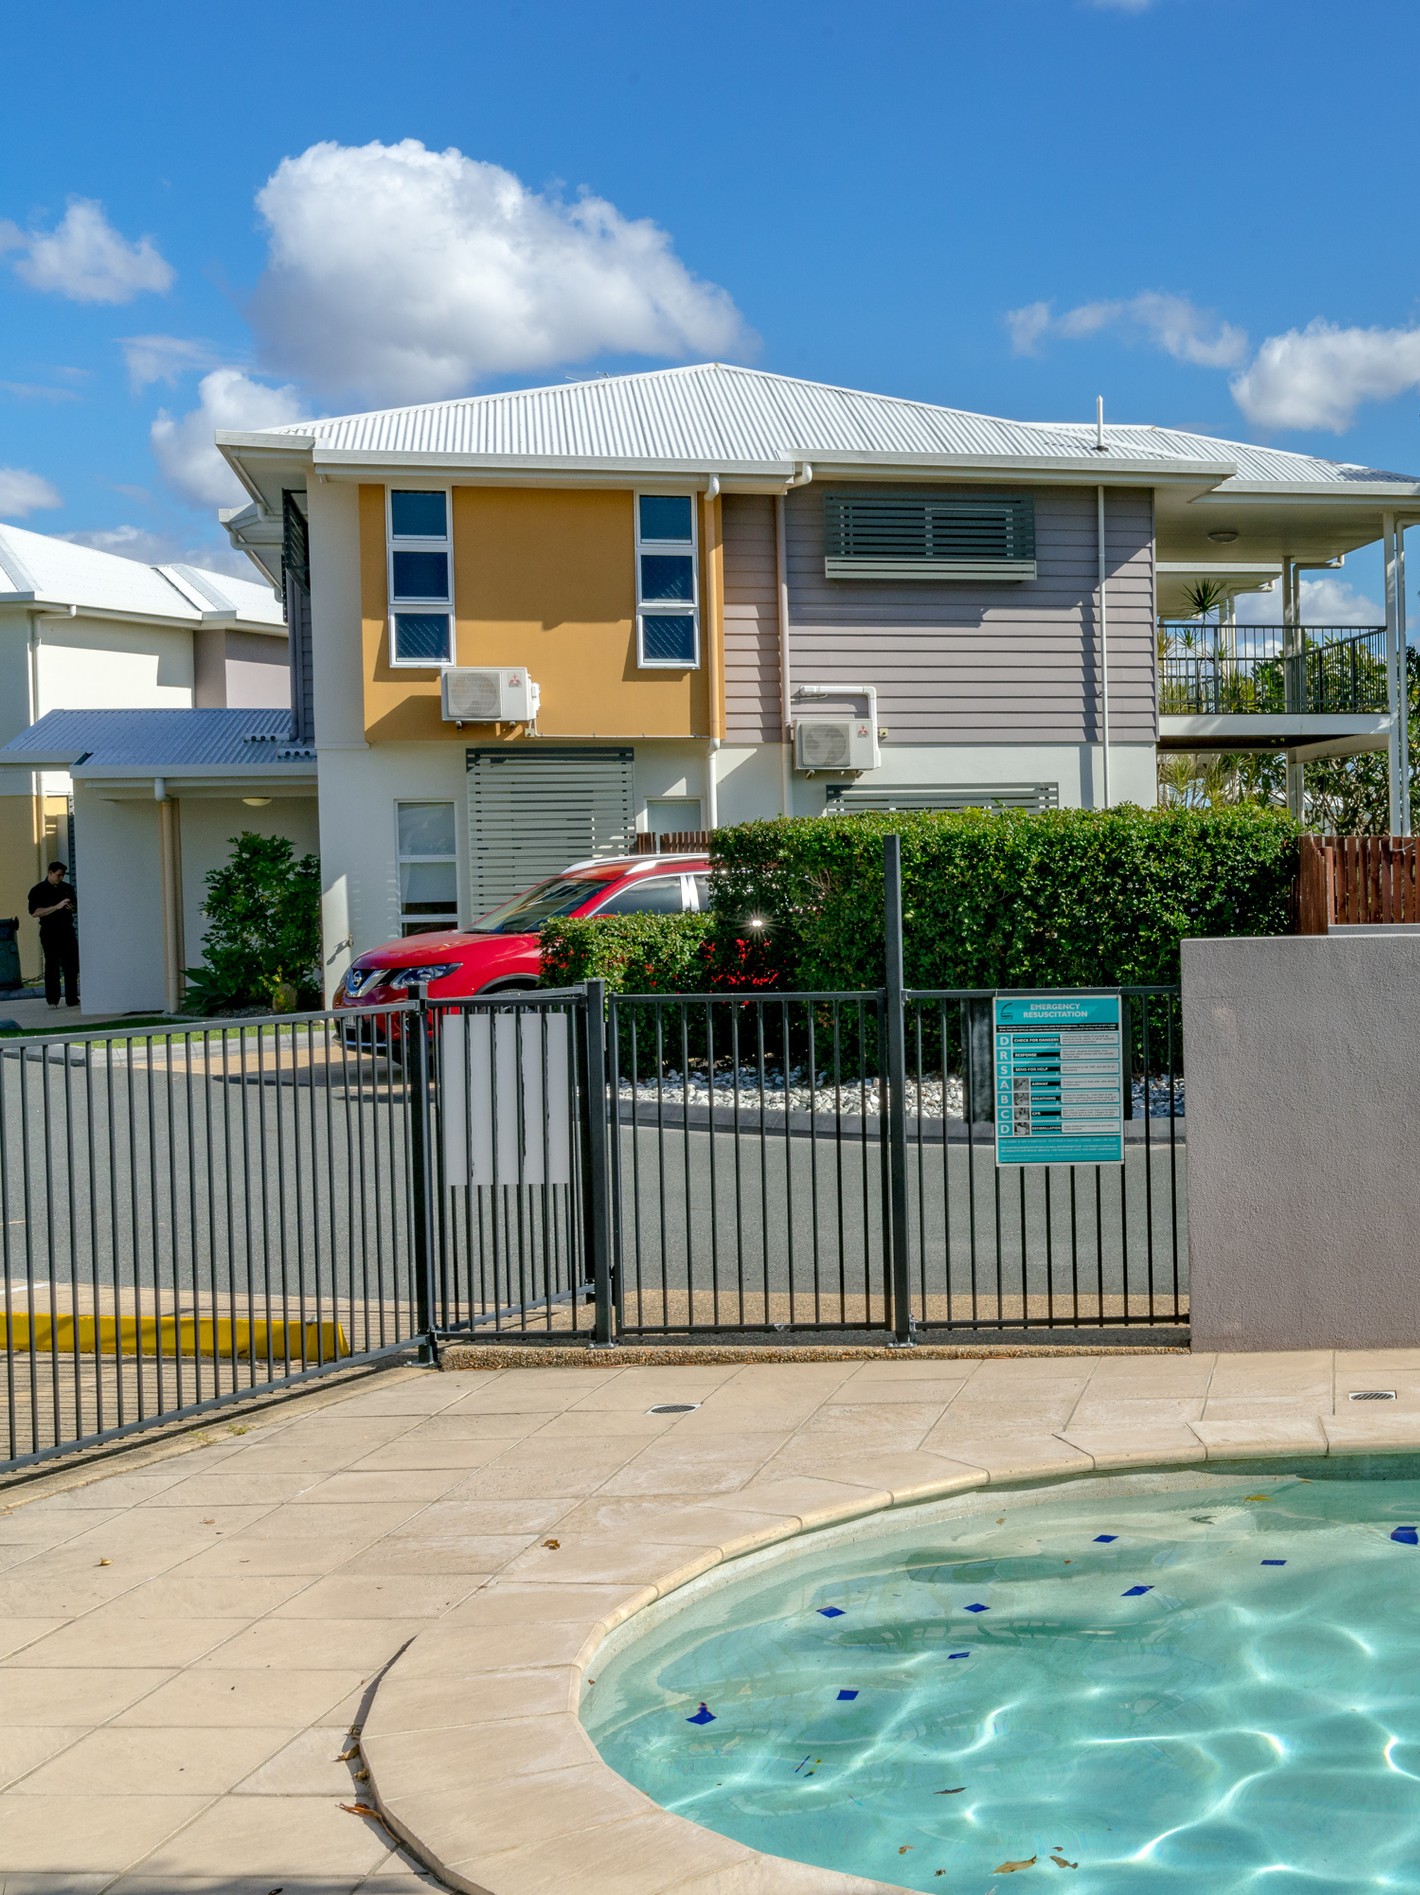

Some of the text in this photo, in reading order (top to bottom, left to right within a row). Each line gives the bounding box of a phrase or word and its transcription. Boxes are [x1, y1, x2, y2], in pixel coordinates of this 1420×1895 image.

[1001, 1037, 1009, 1046] D
[1000, 1051, 1008, 1060] R
[1000, 1066, 1008, 1074] S
[1000, 1080, 1010, 1089] A
[1001, 1095, 1009, 1104] B
[1000, 1110, 1010, 1119] C
[1001, 1124, 1010, 1134] D
